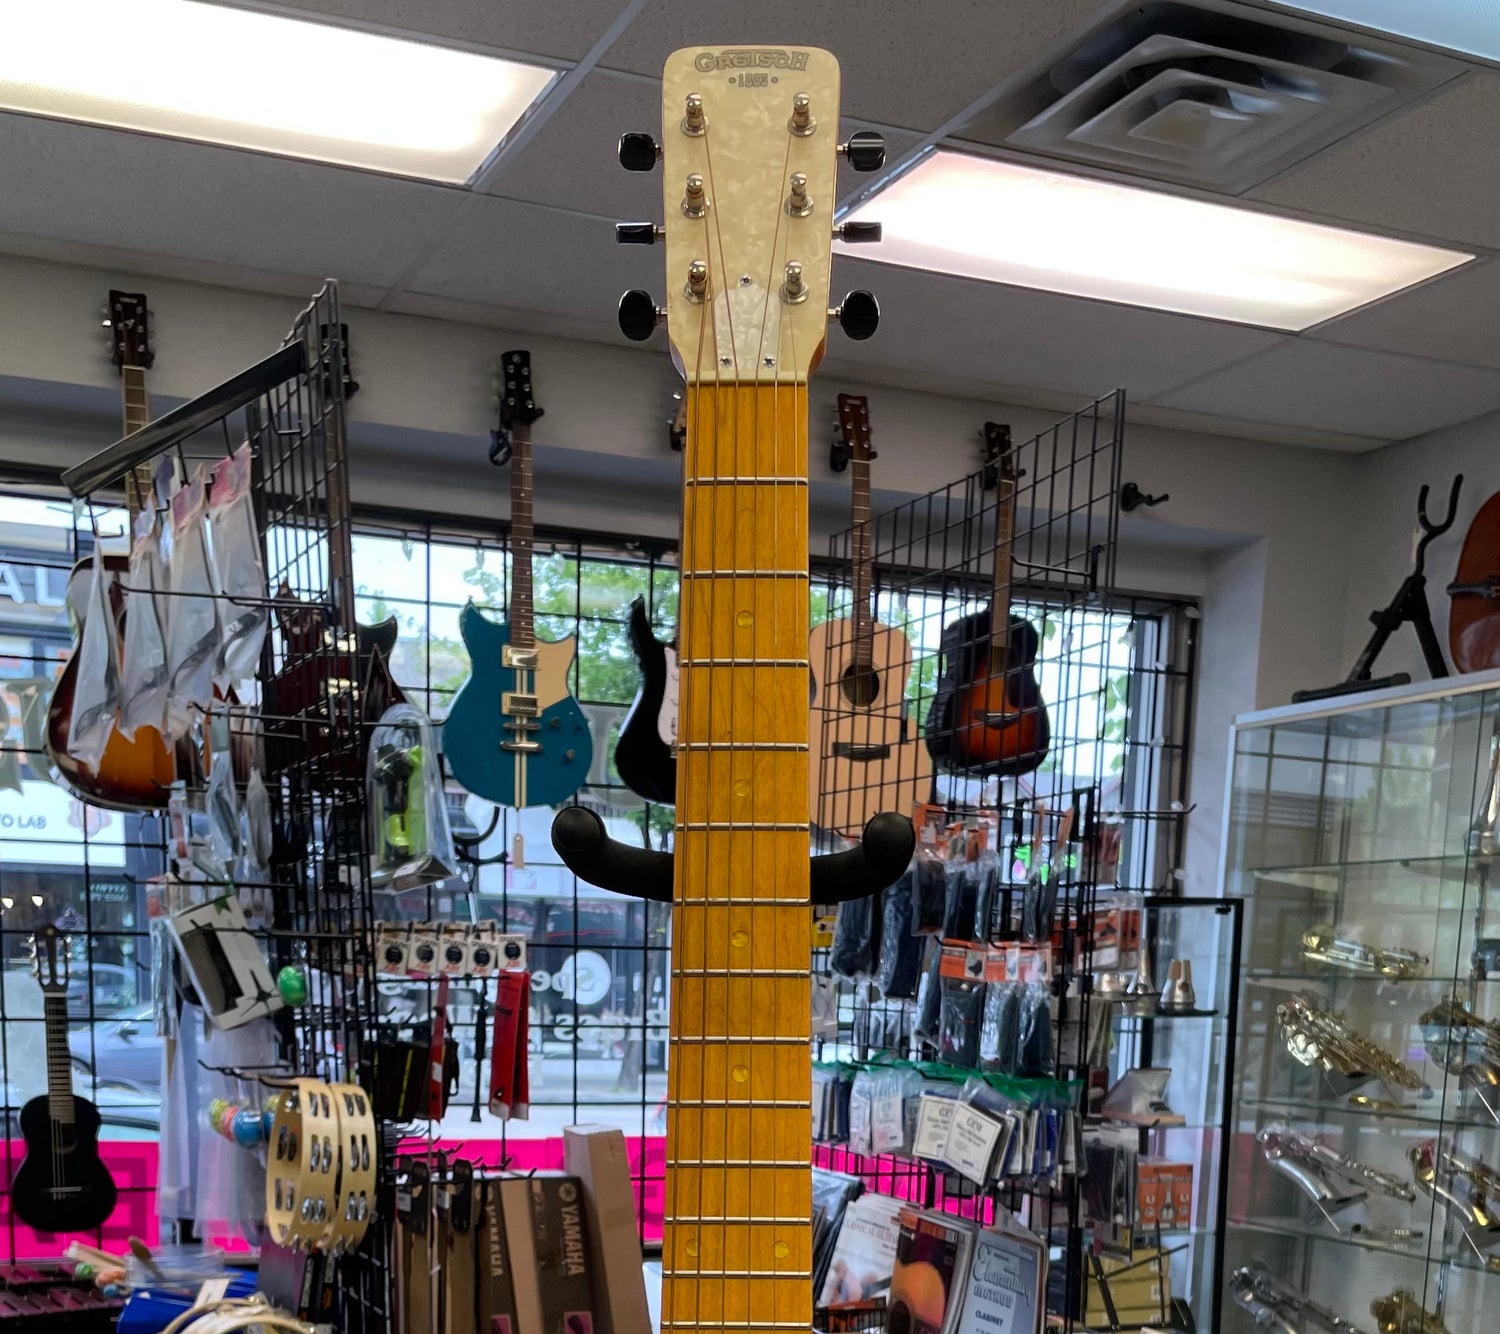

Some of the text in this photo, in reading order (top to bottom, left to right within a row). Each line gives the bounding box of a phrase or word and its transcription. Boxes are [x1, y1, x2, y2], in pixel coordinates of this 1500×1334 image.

[17, 815, 47, 829] LAB
[561, 1204, 585, 1276] YAMAHA
[975, 1310, 1004, 1327] CLARINET
